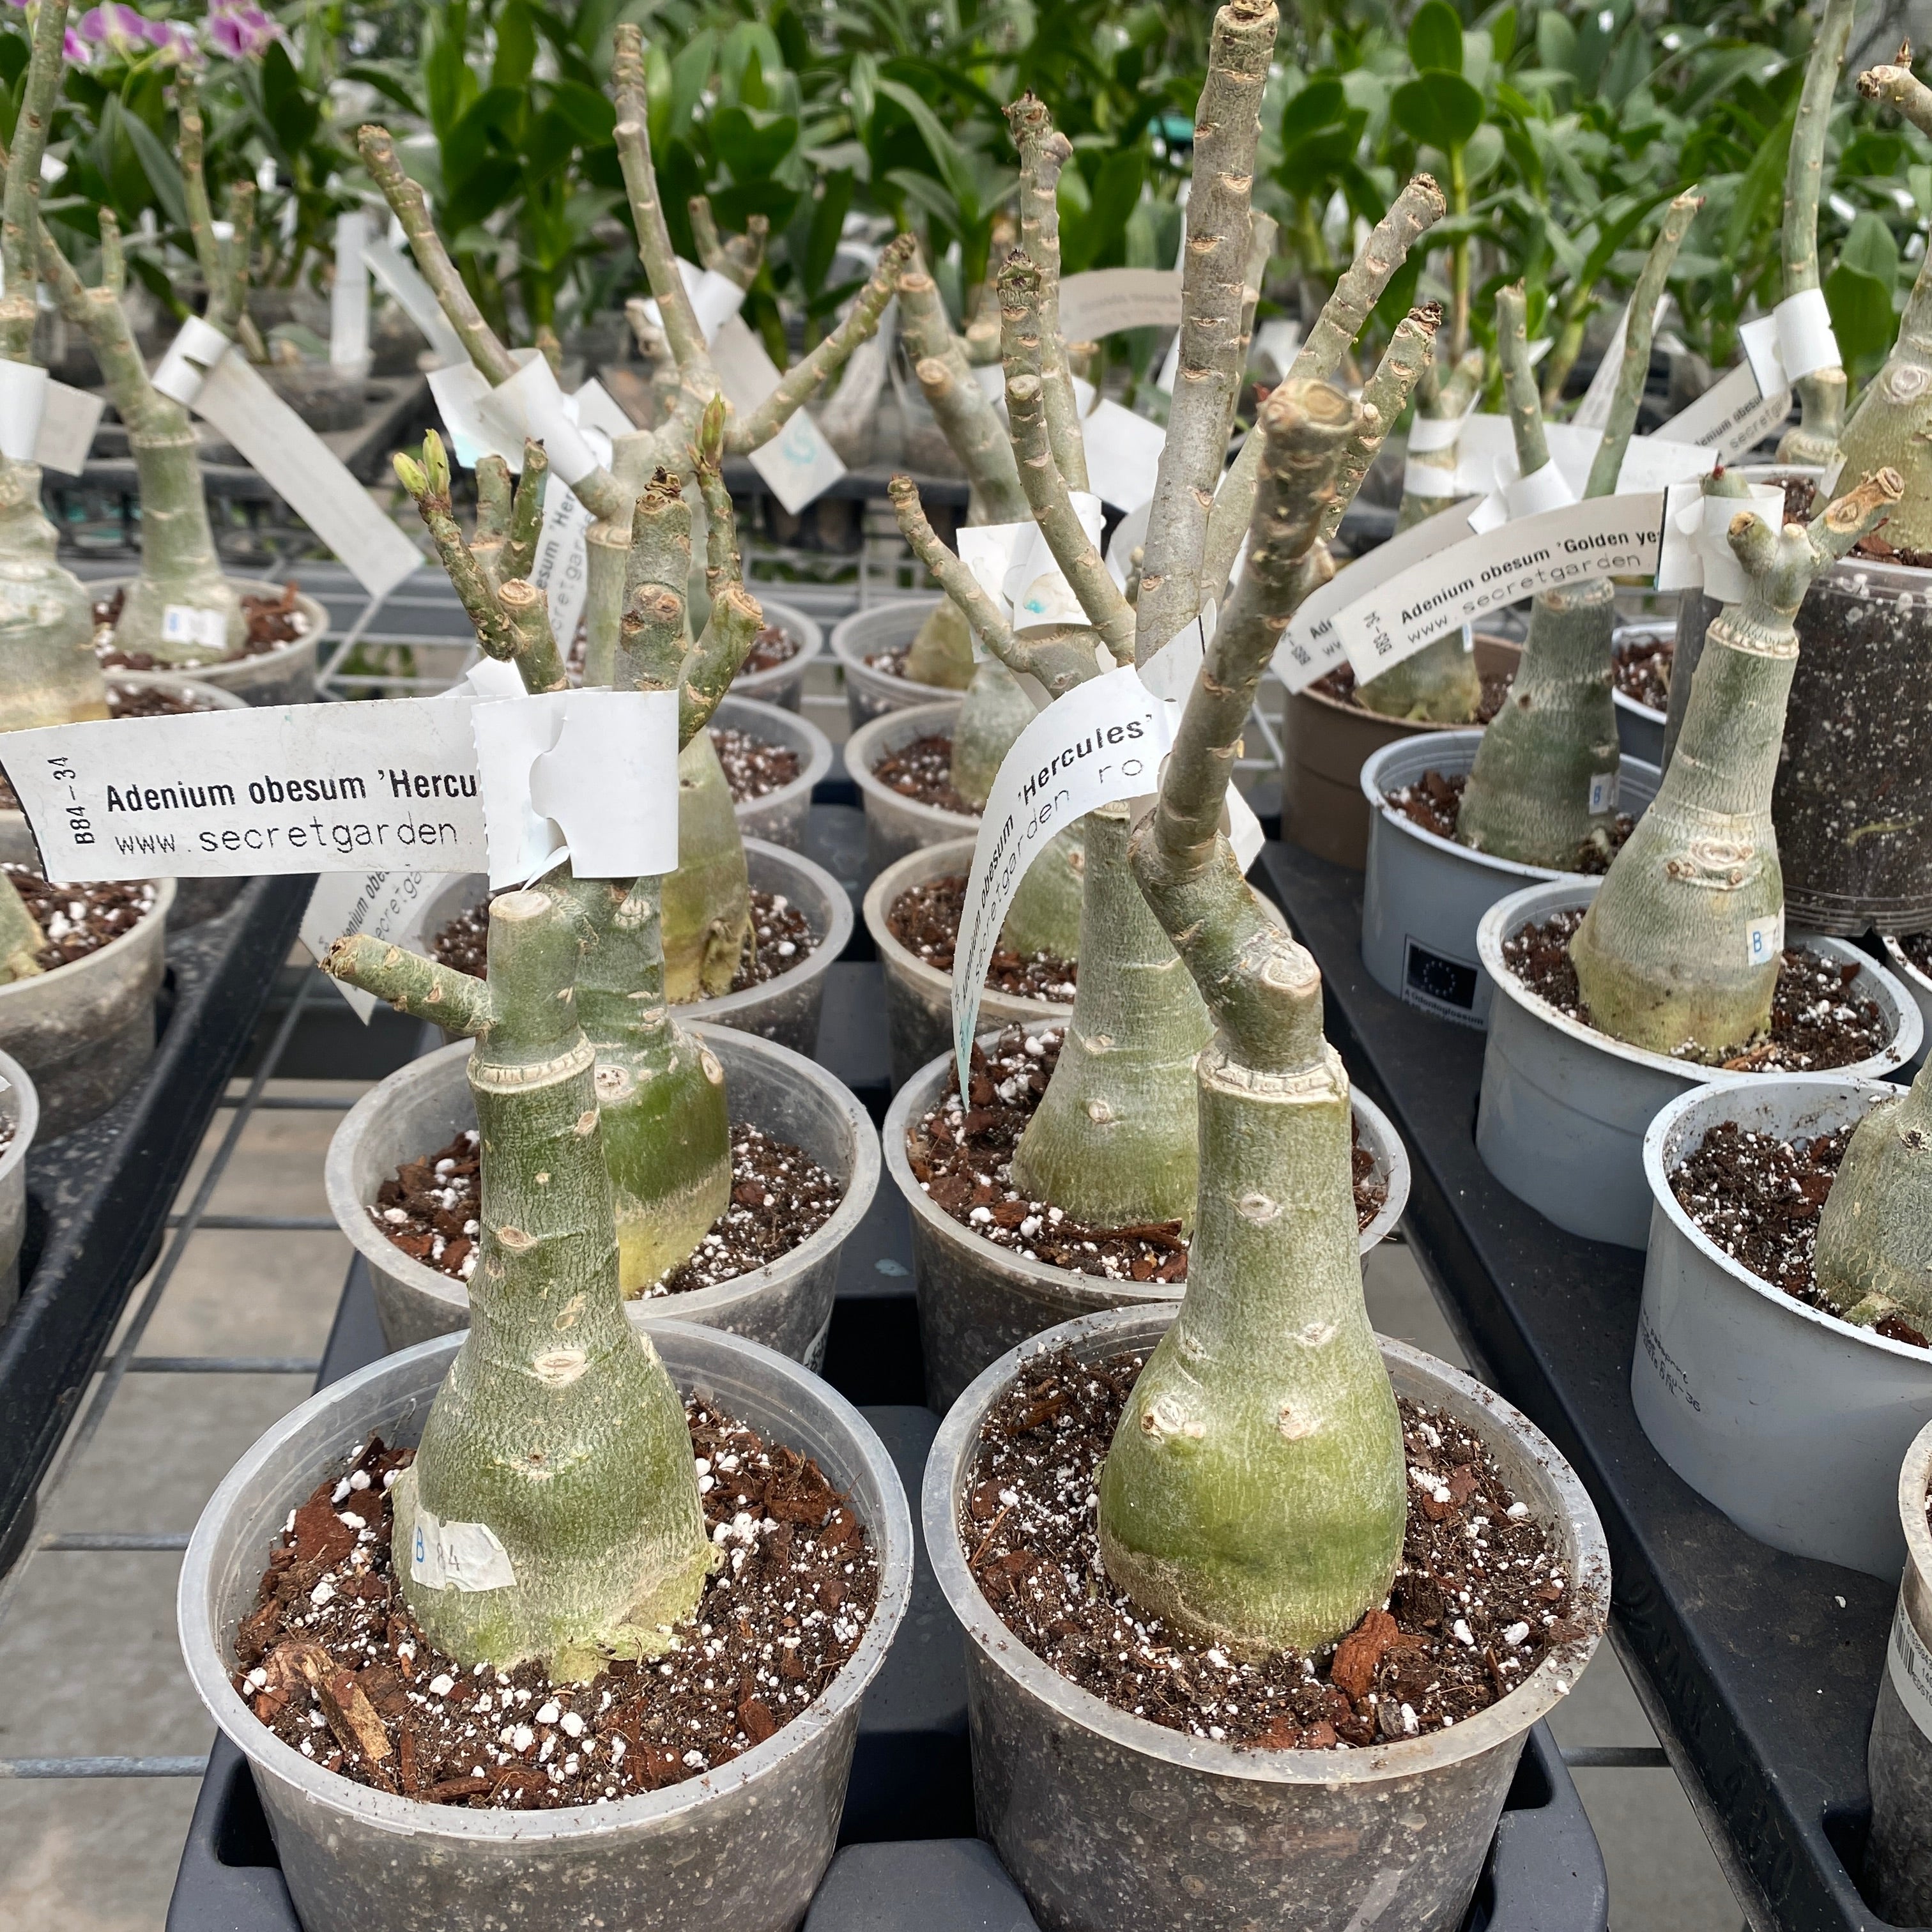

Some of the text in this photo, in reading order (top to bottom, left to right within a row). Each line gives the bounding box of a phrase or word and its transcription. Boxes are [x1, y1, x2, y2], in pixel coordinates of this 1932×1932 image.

[1401, 578, 1475, 624] Adenium
[1480, 548, 1550, 583] obesum
[107, 781, 236, 812] Adenium
[249, 775, 366, 804] obesum
[1099, 759, 1144, 785] ro
[981, 814, 1014, 910] obesum
[1017, 713, 1153, 806] 'Hercules'
